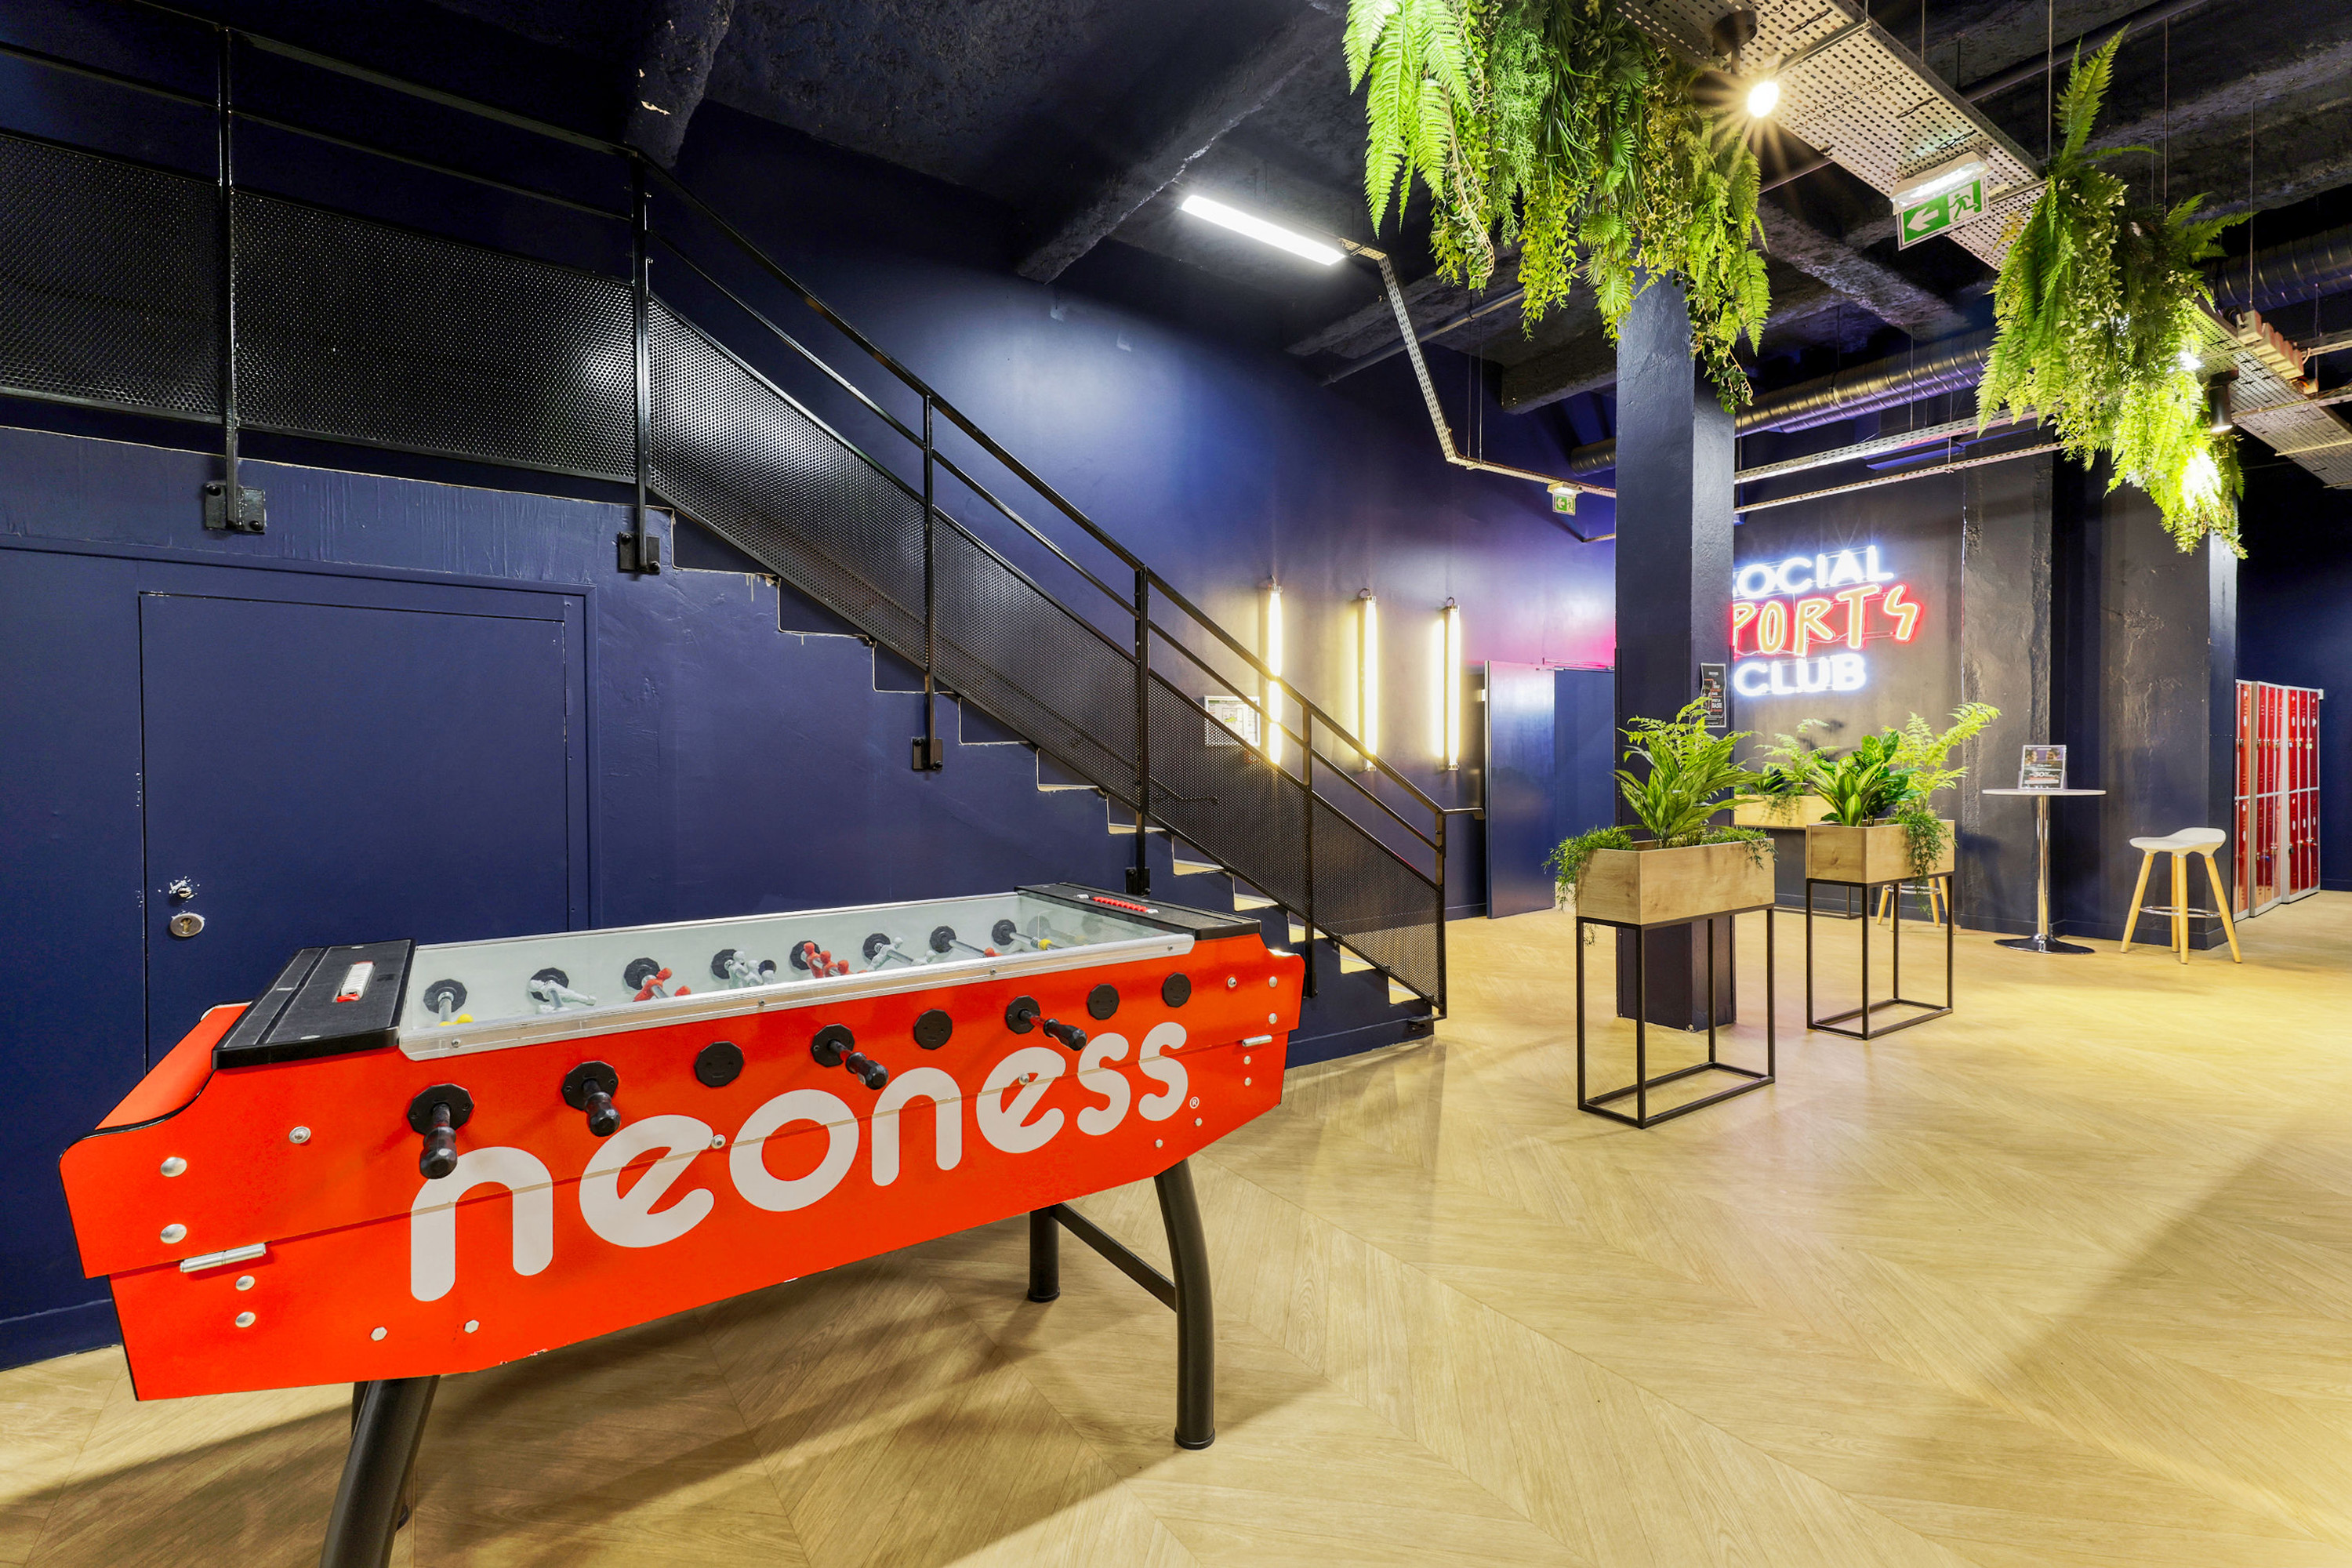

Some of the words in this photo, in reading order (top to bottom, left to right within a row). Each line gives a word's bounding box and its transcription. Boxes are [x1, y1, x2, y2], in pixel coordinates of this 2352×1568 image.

[1732, 546, 1894, 598] OCIAL
[1733, 585, 1918, 656] PORTS
[1733, 653, 1867, 696] CLUB
[411, 1022, 1189, 1301] neoness
